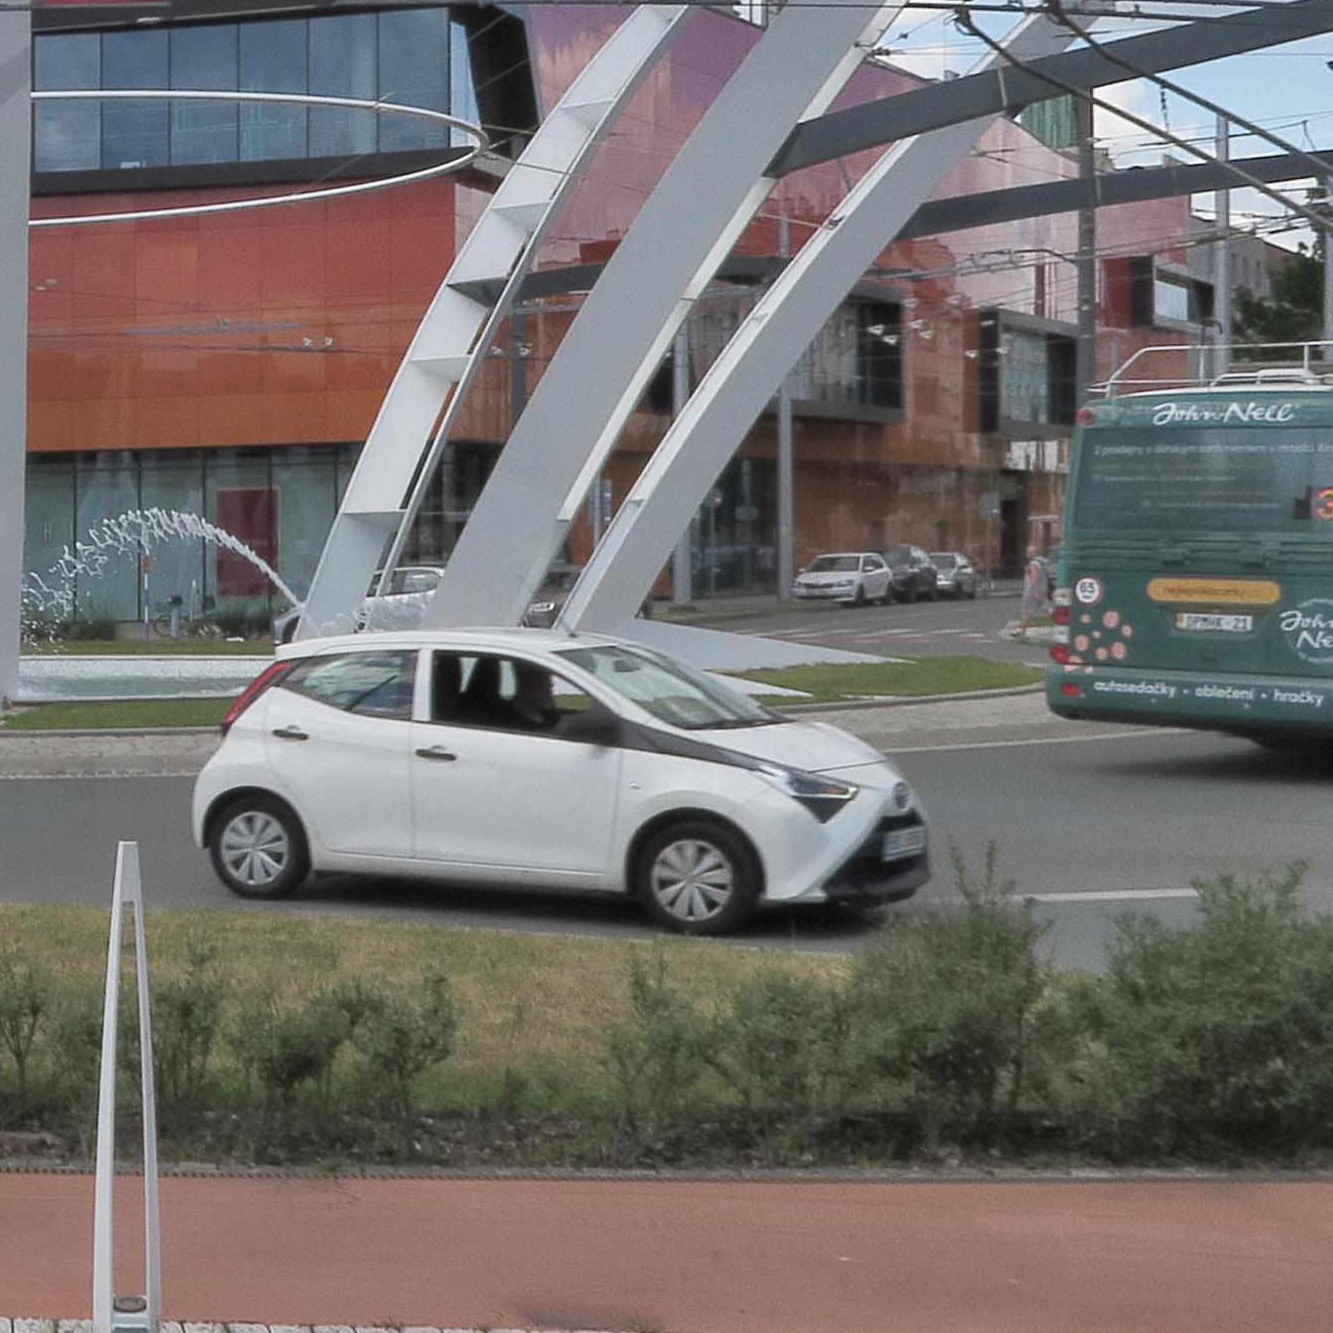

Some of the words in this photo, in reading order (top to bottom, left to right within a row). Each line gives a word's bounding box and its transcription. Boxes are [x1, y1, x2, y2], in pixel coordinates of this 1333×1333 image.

[1151, 402, 1219, 425] John
[1221, 402, 1295, 423] Nell
[1297, 631, 1333, 648] Ne
